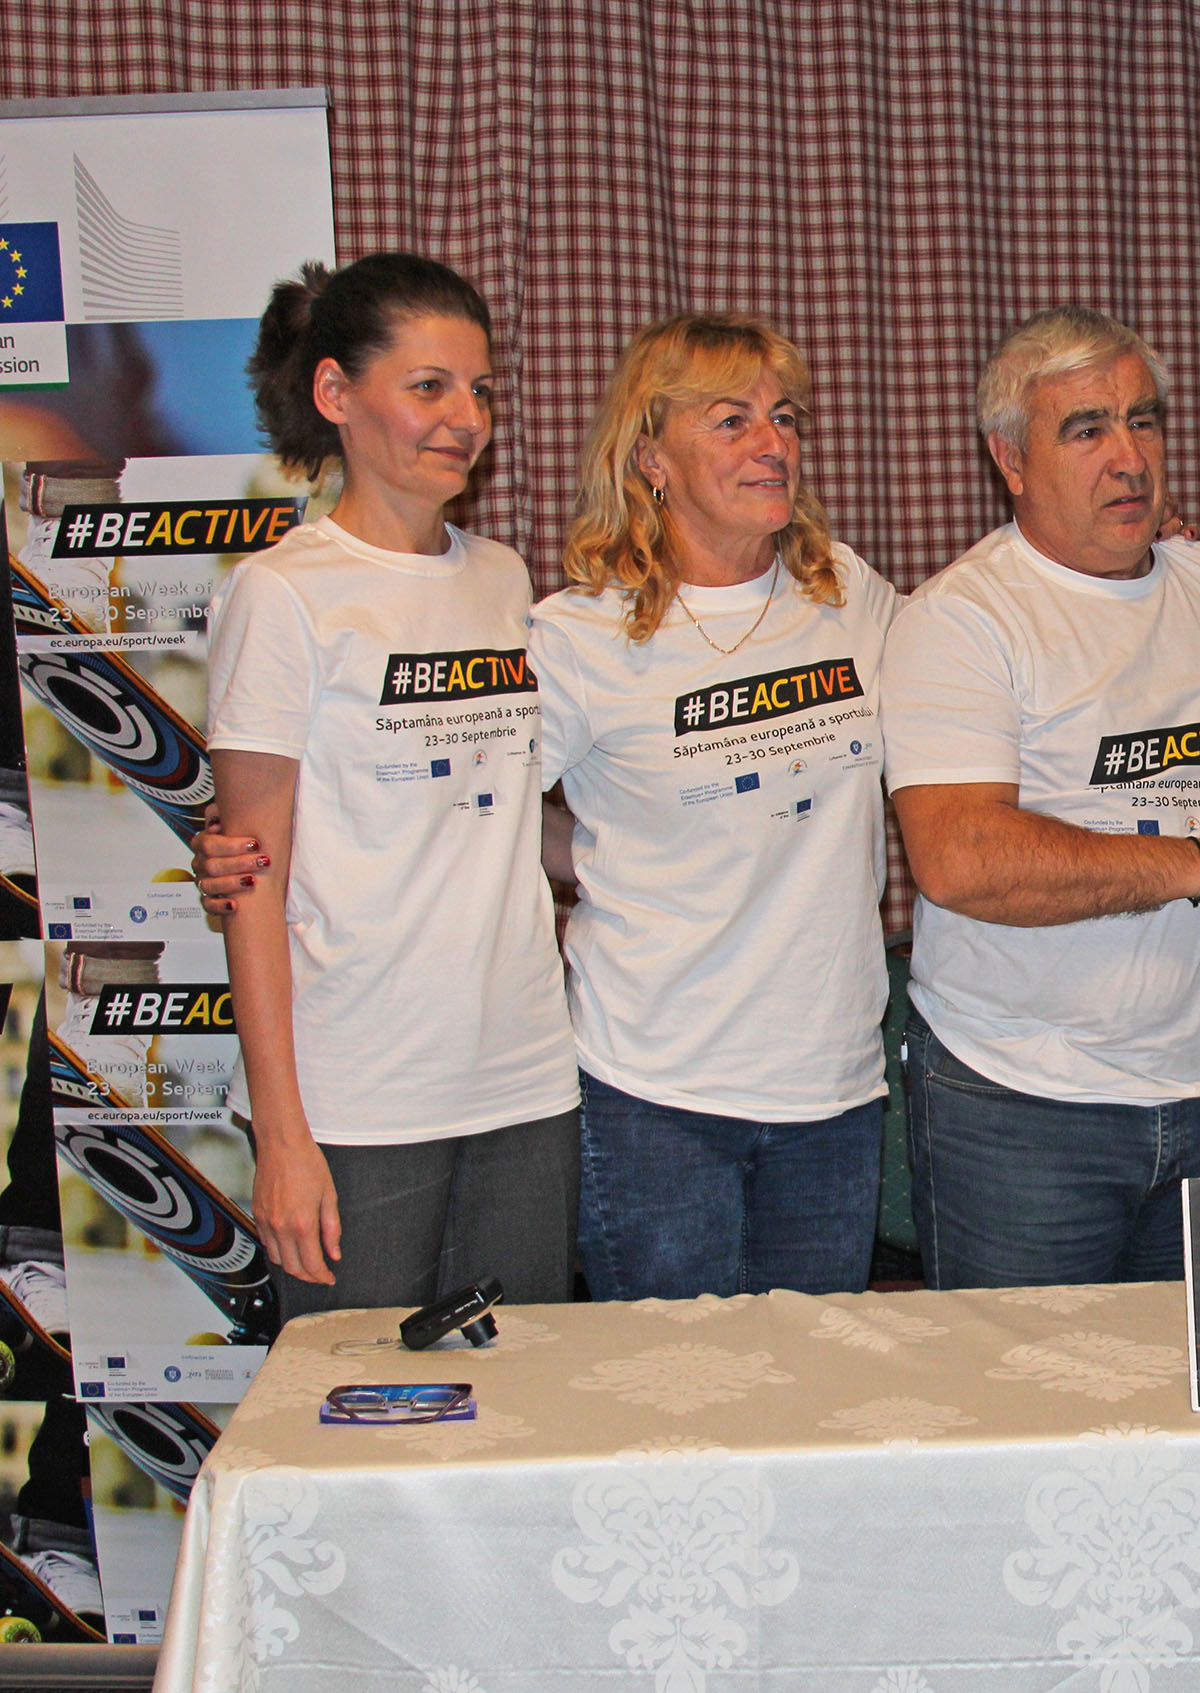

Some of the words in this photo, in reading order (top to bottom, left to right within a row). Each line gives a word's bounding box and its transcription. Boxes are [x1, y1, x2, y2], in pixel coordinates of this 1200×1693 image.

[66, 506, 294, 549] #BEACTIVE
[49, 583, 131, 602] European
[137, 581, 189, 596] Week
[48, 607, 73, 622] 23
[50, 634, 186, 649] ec.europa.eu/sport/week
[392, 655, 536, 695] #BEACTIV
[682, 665, 855, 726] #BEACTIVE
[376, 714, 443, 734] Săptamâna
[446, 706, 503, 726] europeană
[505, 708, 512, 718] a
[462, 725, 517, 744] Septembrie
[673, 735, 747, 759] Săptamâna
[750, 718, 816, 742] europeană
[819, 718, 826, 727] a
[769, 732, 836, 757] Septembrie
[87, 1059, 168, 1078] European
[176, 1059, 226, 1073] Week
[87, 1081, 111, 1096] 23
[88, 1110, 223, 1123] ec.europa.eu/sport/week
